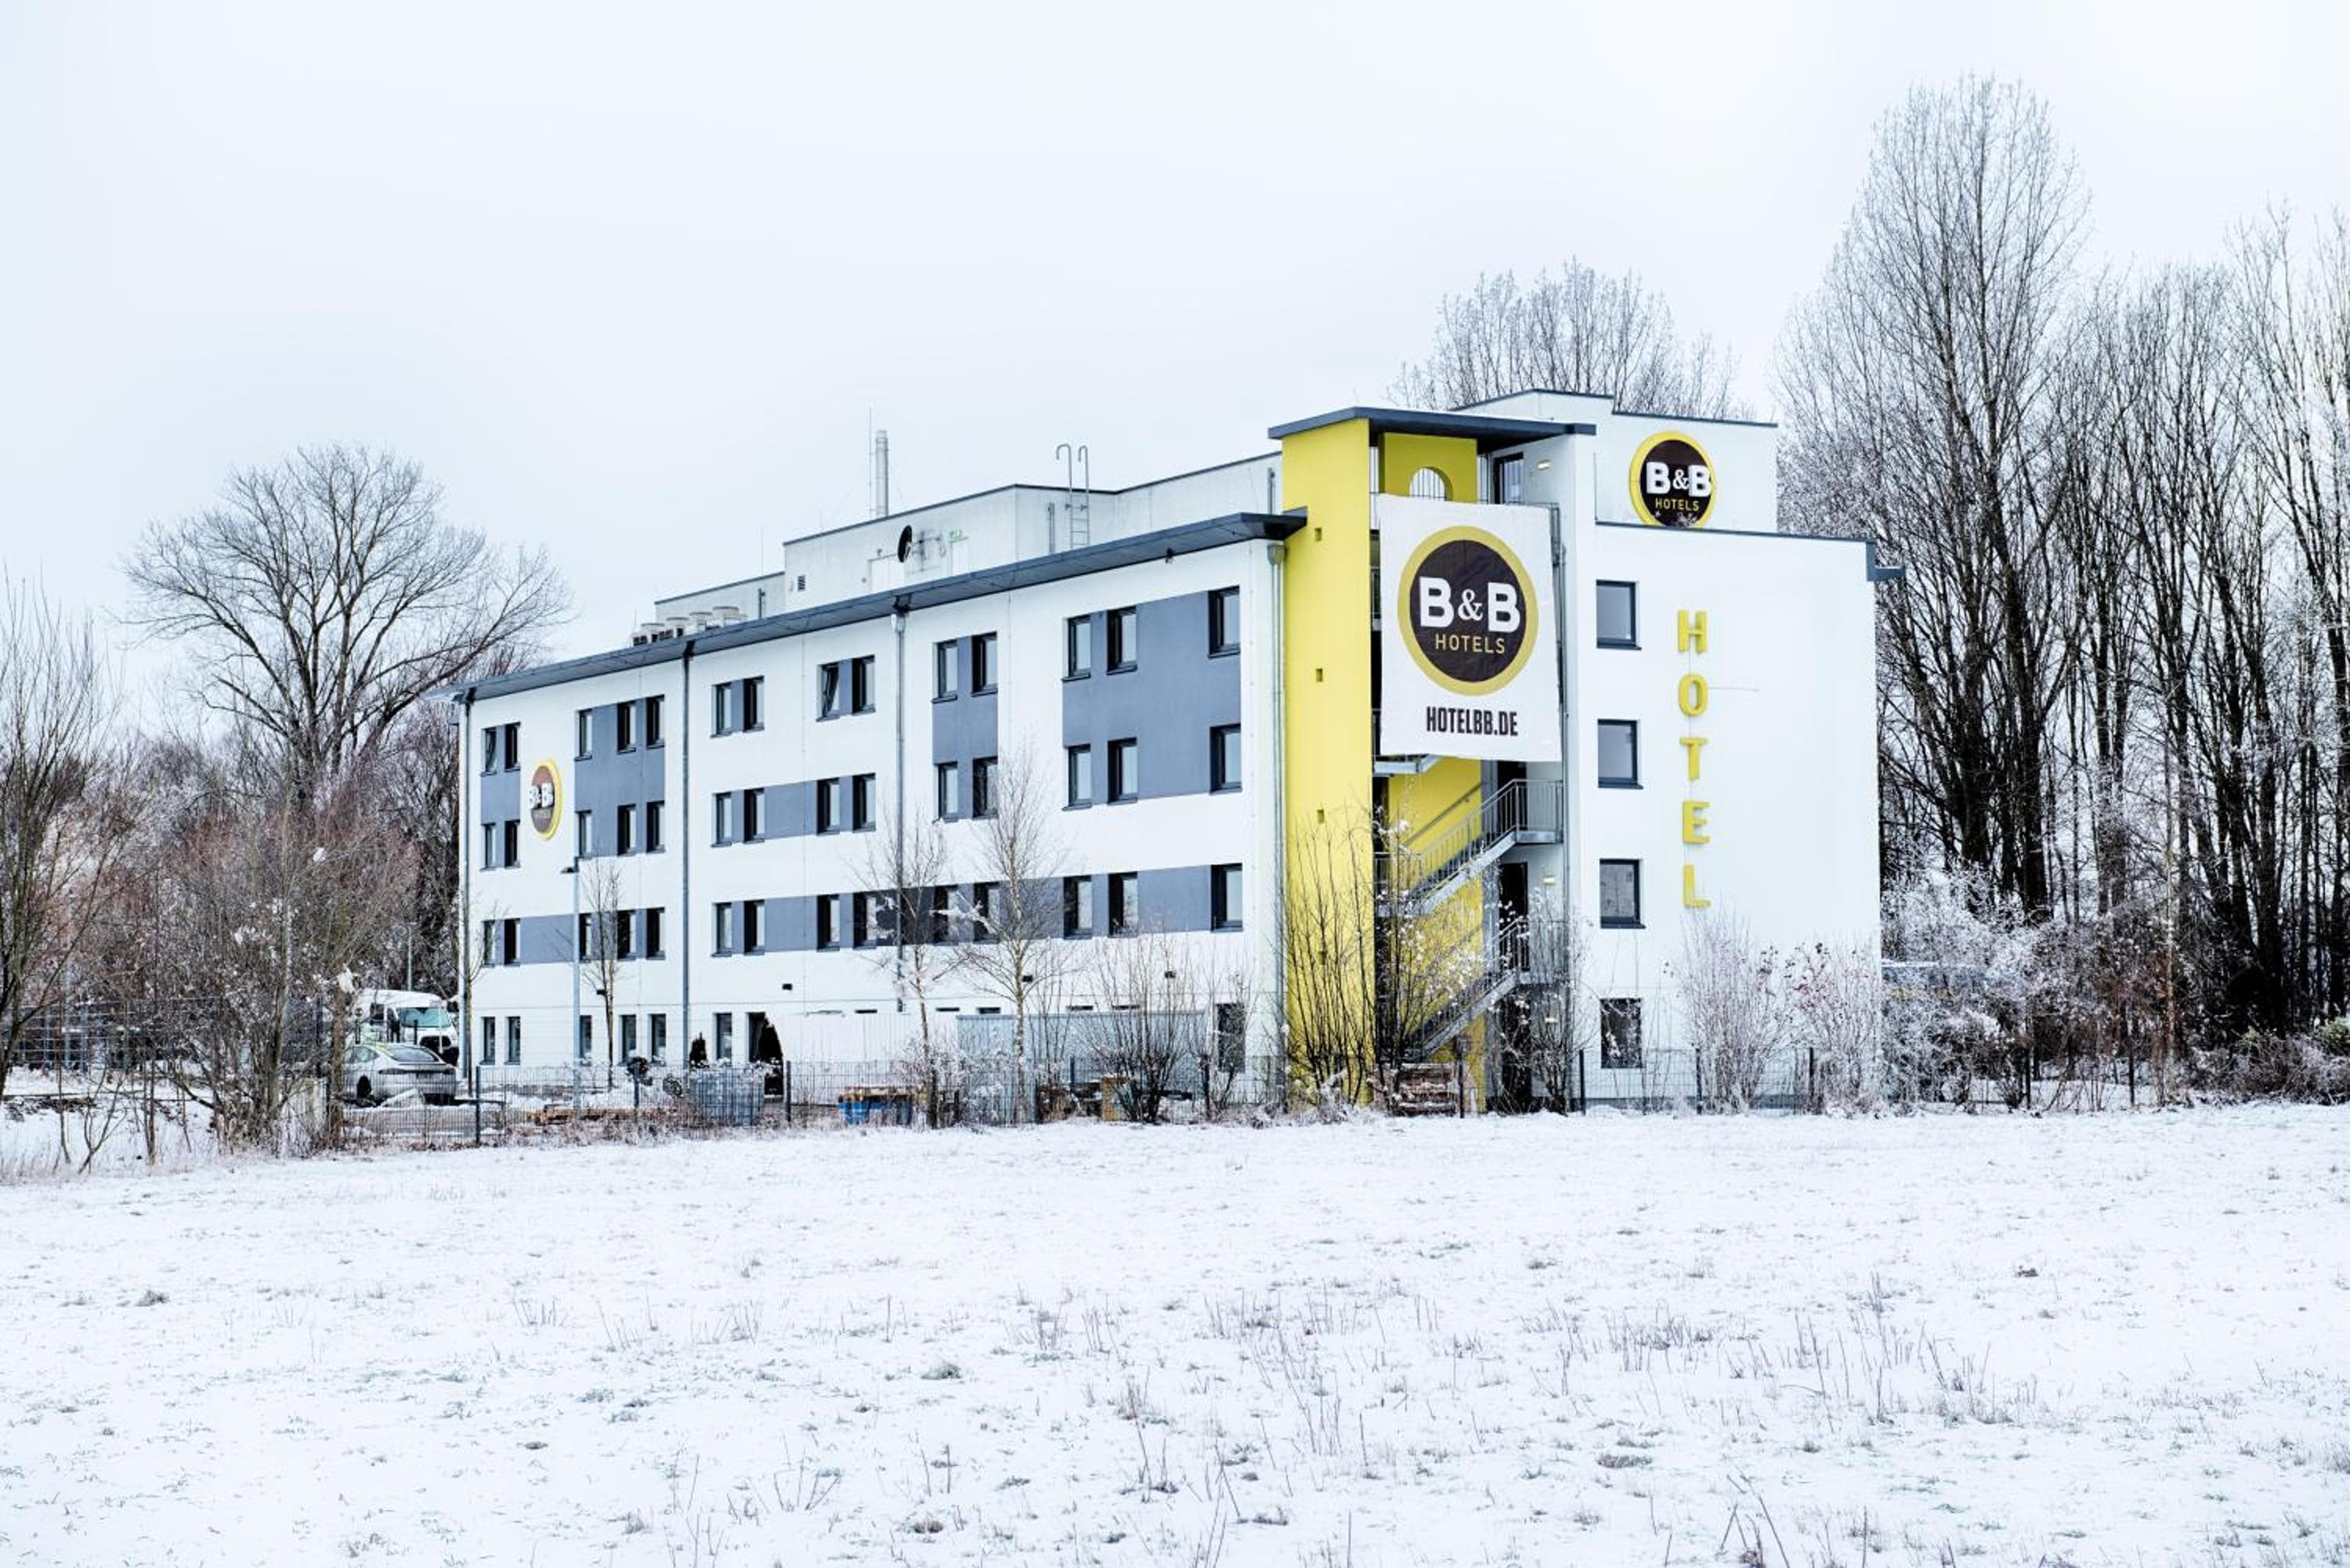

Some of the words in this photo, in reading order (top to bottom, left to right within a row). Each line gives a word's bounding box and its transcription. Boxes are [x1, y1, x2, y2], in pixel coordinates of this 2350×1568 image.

[1647, 462, 1711, 497] B&B
[1655, 497, 1699, 511] HOTELS
[1419, 576, 1520, 633] B&B
[1435, 634, 1505, 653] HOTELS
[1426, 706, 1518, 736] HOTELBB.DE
[1678, 610, 1710, 908] HOTEL
